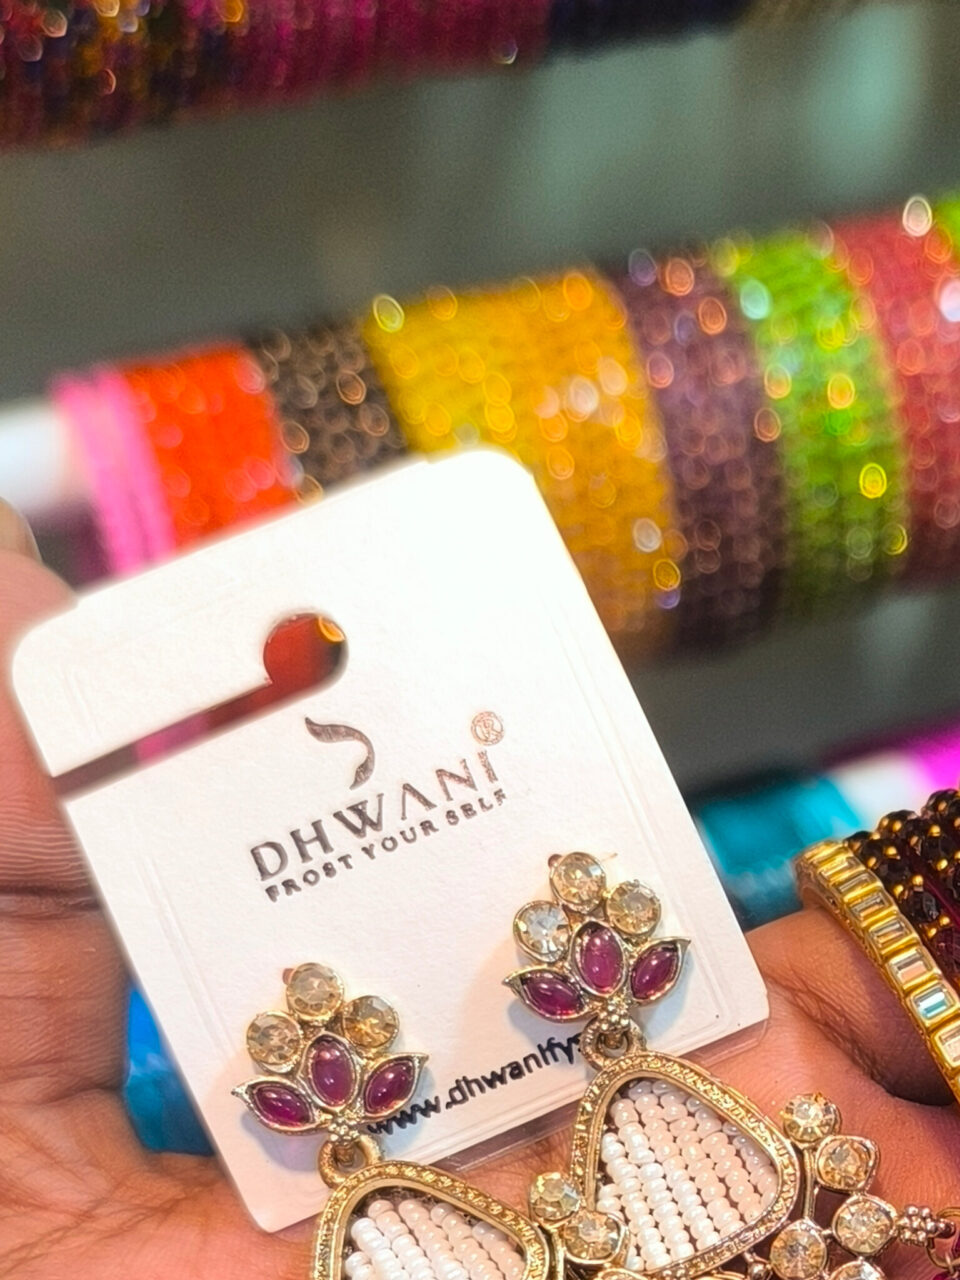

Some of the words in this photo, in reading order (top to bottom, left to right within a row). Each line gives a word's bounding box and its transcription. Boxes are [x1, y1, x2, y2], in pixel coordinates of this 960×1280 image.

[250, 750, 499, 882] DHWANI
[265, 854, 354, 903] FROST
[361, 819, 440, 861] YOUR
[445, 788, 507, 826] SELF
